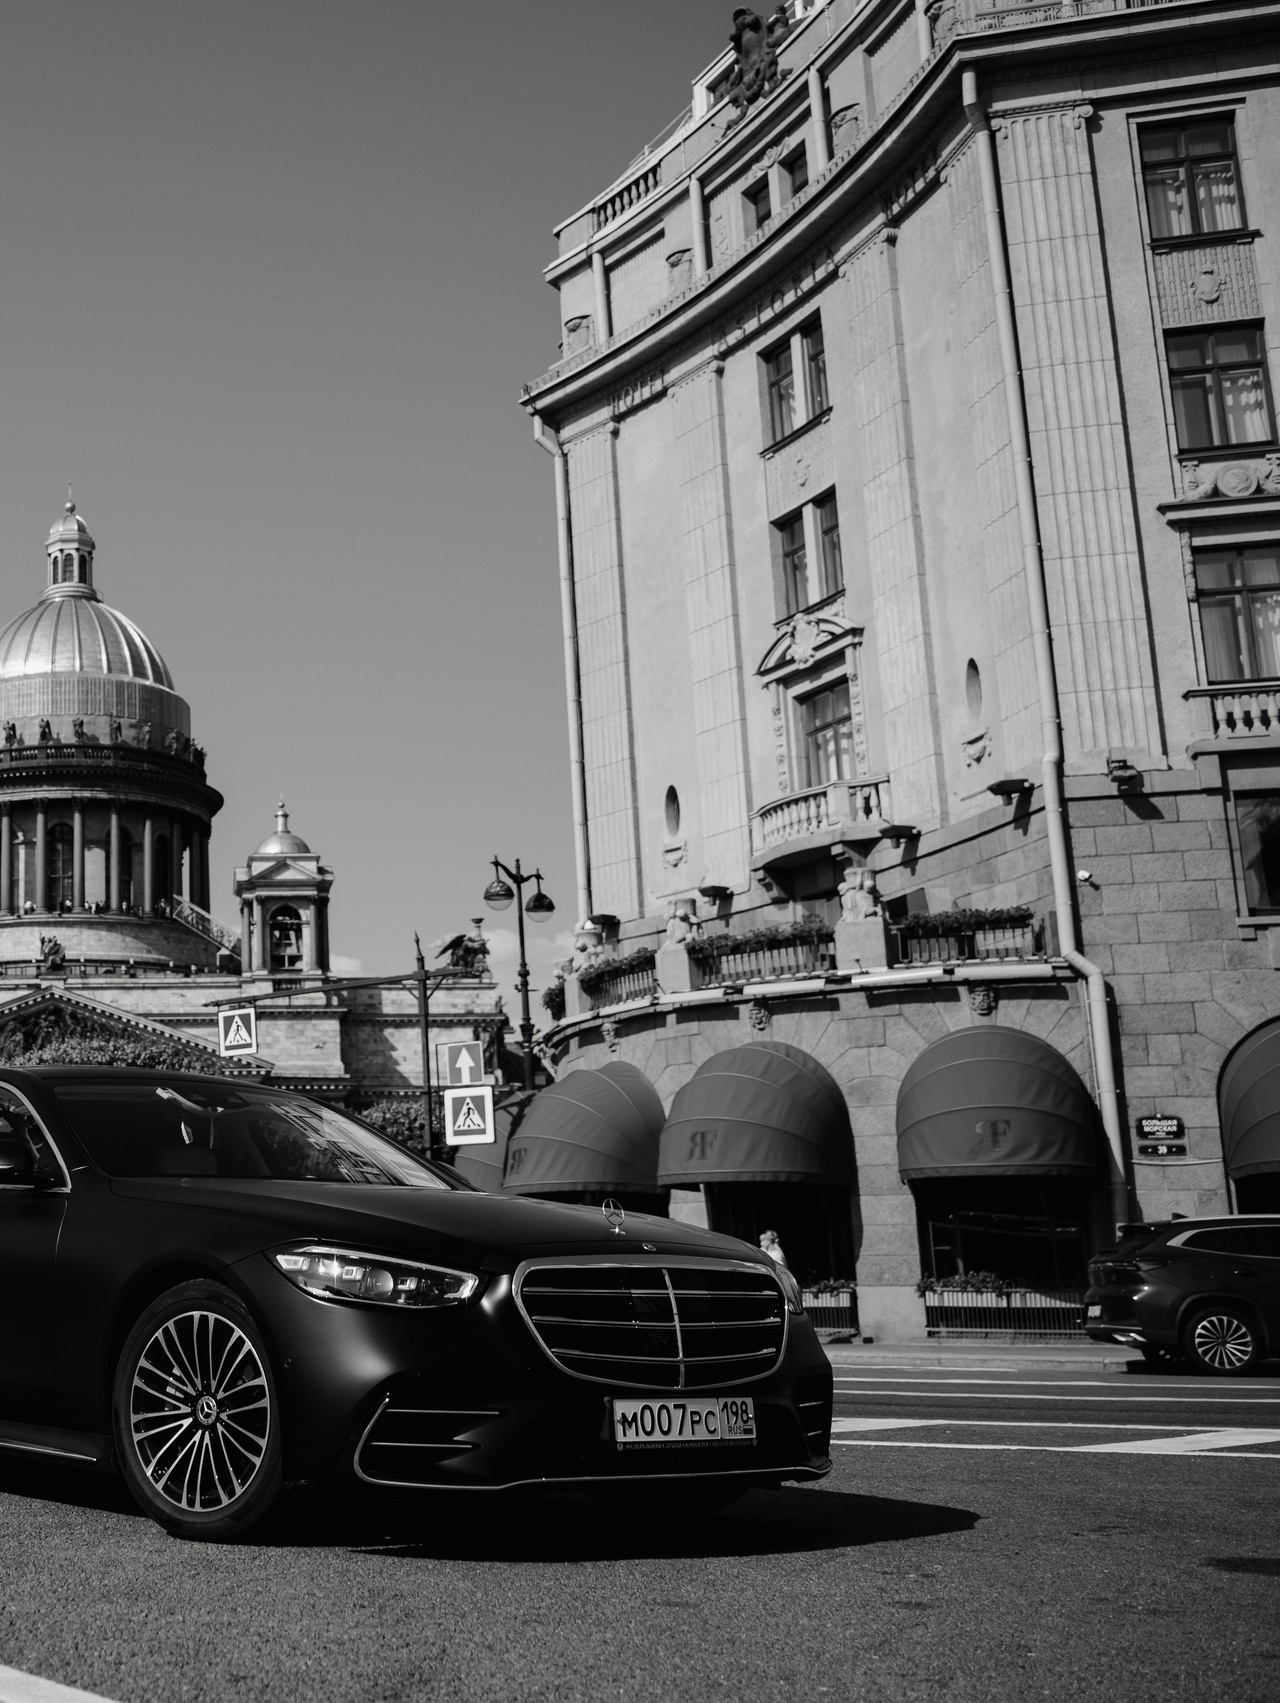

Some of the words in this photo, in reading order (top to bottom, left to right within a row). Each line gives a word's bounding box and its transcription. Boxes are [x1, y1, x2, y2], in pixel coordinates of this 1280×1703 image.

[1157, 1145, 1168, 1154] 39
[721, 1401, 749, 1425] 198
[728, 1426, 743, 1435] RUS
